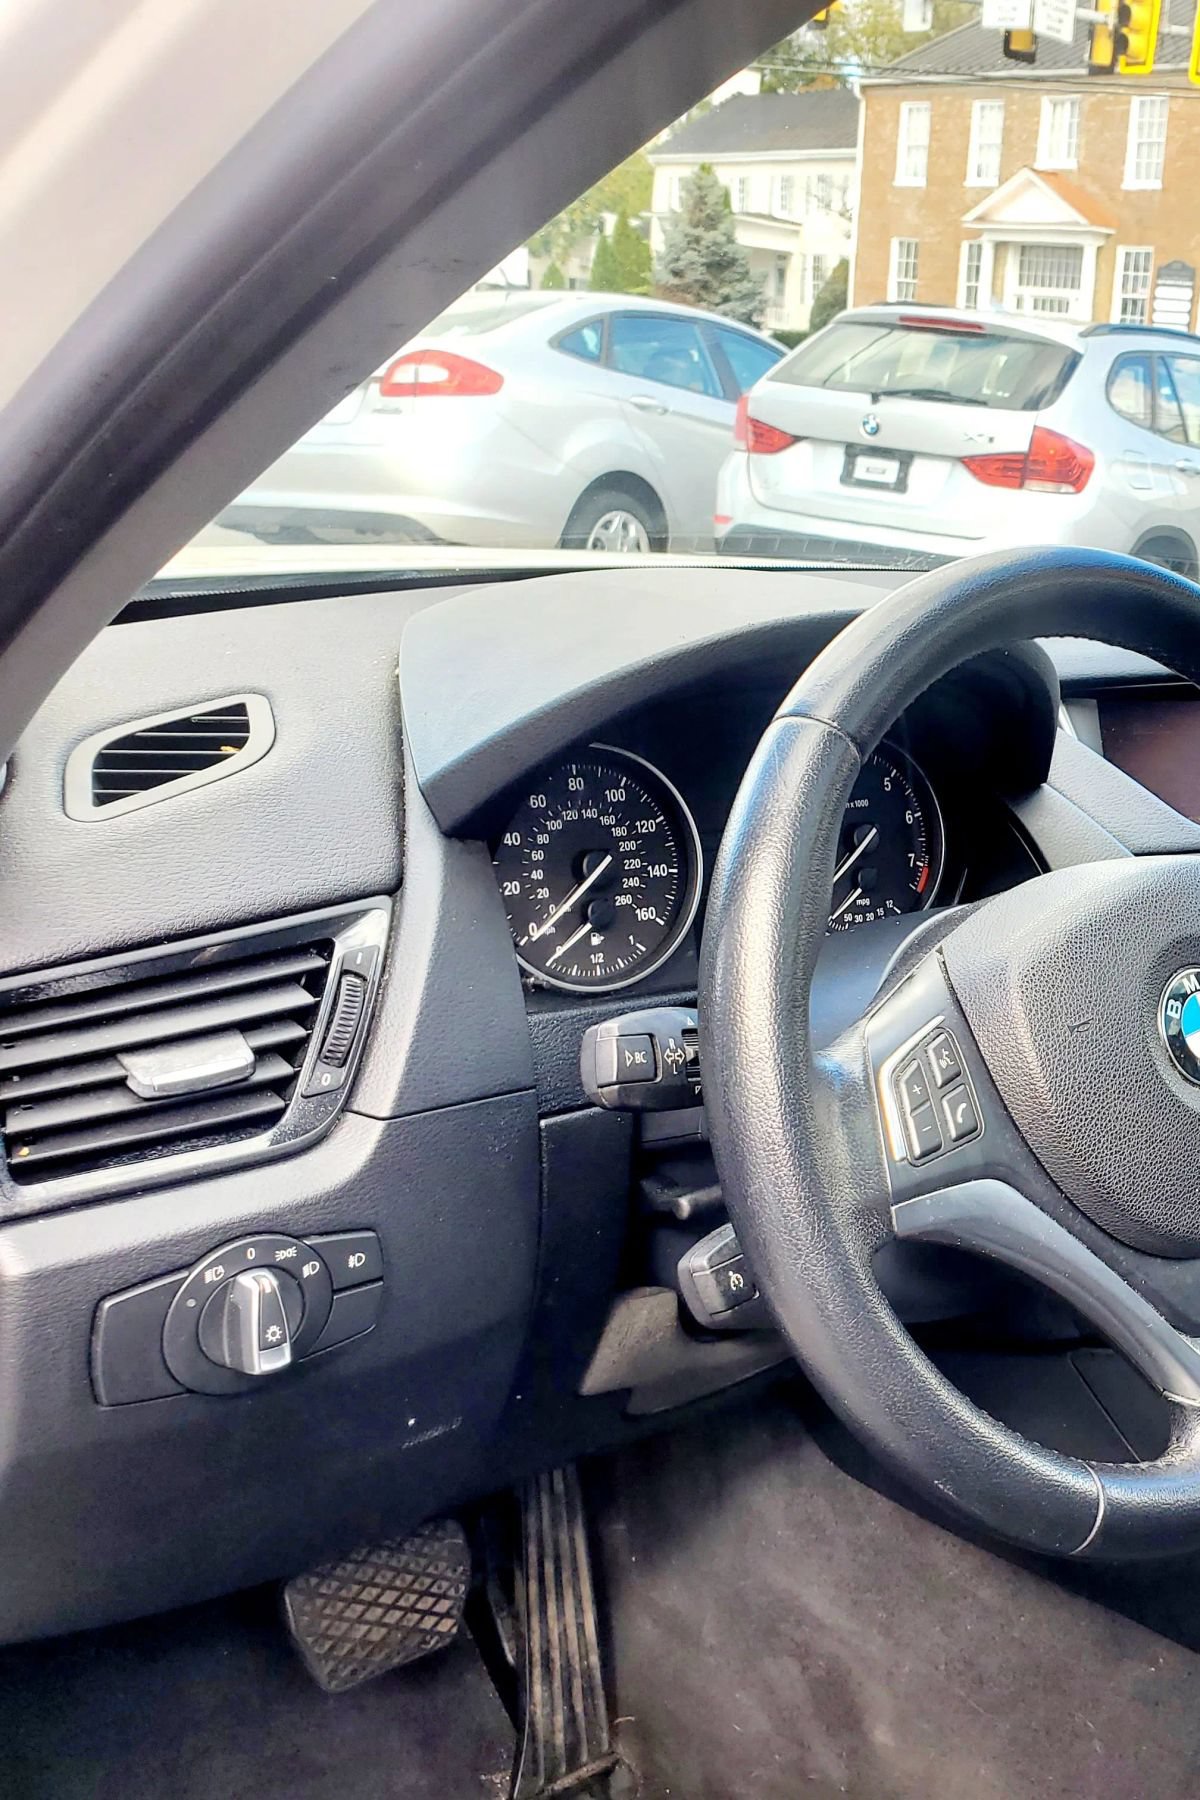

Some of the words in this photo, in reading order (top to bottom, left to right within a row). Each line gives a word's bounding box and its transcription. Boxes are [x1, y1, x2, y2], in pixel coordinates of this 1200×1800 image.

[568, 778, 584, 790] 80
[884, 778, 891, 791] 5
[605, 789, 625, 802] 100
[530, 795, 546, 808] 60
[562, 810, 578, 820] 120
[581, 808, 597, 818] 140
[906, 811, 913, 824] 6
[546, 820, 562, 831] 100
[600, 815, 615, 826] 160
[612, 826, 627, 837] 180
[636, 820, 655, 833] 120
[504, 832, 520, 846] 40
[537, 834, 549, 844] 80
[619, 840, 635, 851] 200
[531, 851, 544, 861] 60
[908, 854, 915, 867] 7
[624, 859, 641, 870] 220
[531, 870, 543, 879] 40
[647, 864, 667, 877] 140
[623, 877, 639, 888] 240
[503, 882, 520, 895] 20
[537, 888, 549, 899] 20
[615, 895, 632, 906] 260
[856, 898, 870, 906] mpg
[886, 900, 893, 908] 12
[636, 906, 655, 921] 160
[844, 913, 852, 921] 50
[866, 912, 875, 921] 20
[876, 908, 884, 916] 15
[855, 914, 863, 922] 30
[529, 923, 537, 937] 0
[629, 935, 634, 944] 1
[590, 953, 604, 963] 1/2
[669, 1038, 676, 1050] R
[634, 1051, 647, 1063] BC
[673, 1062, 678, 1075] L
